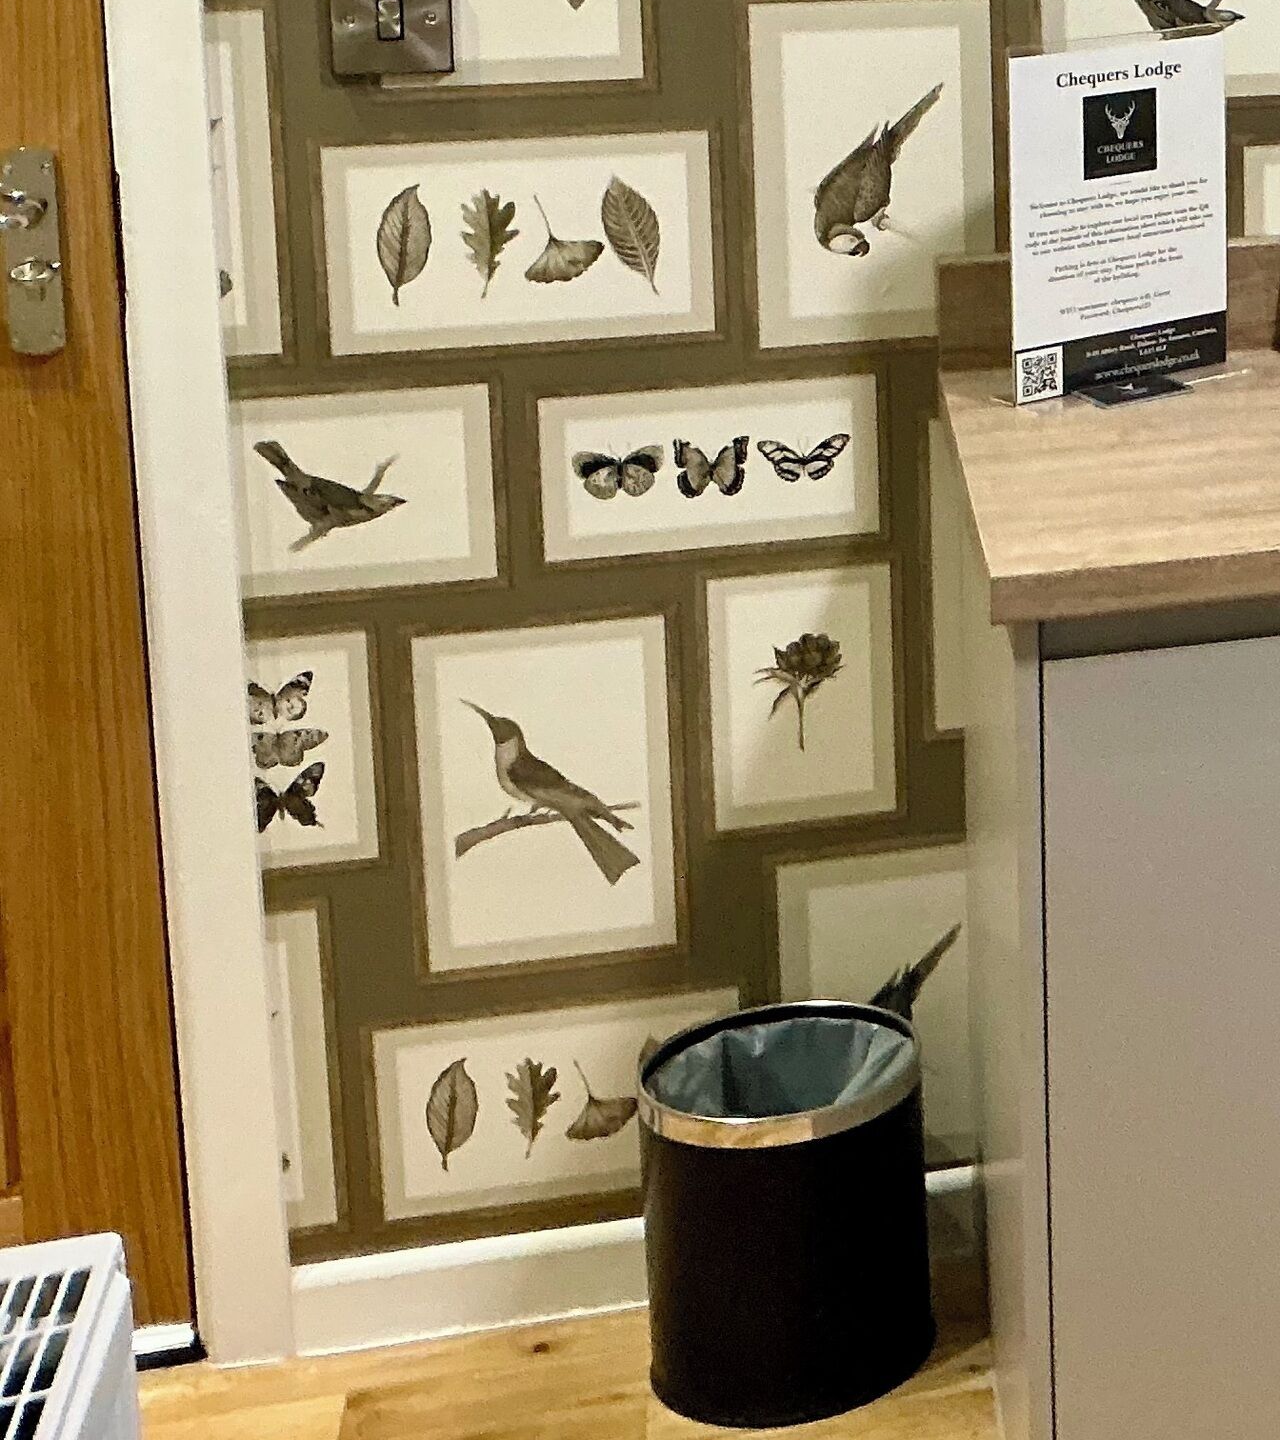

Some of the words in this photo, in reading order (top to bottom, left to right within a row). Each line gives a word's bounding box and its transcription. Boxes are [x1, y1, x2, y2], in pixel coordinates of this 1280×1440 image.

[1056, 67, 1129, 88] Chequers
[1134, 61, 1182, 79] Lodge
[1097, 140, 1144, 154] CHEQUERS
[1106, 152, 1136, 164] LODGE
